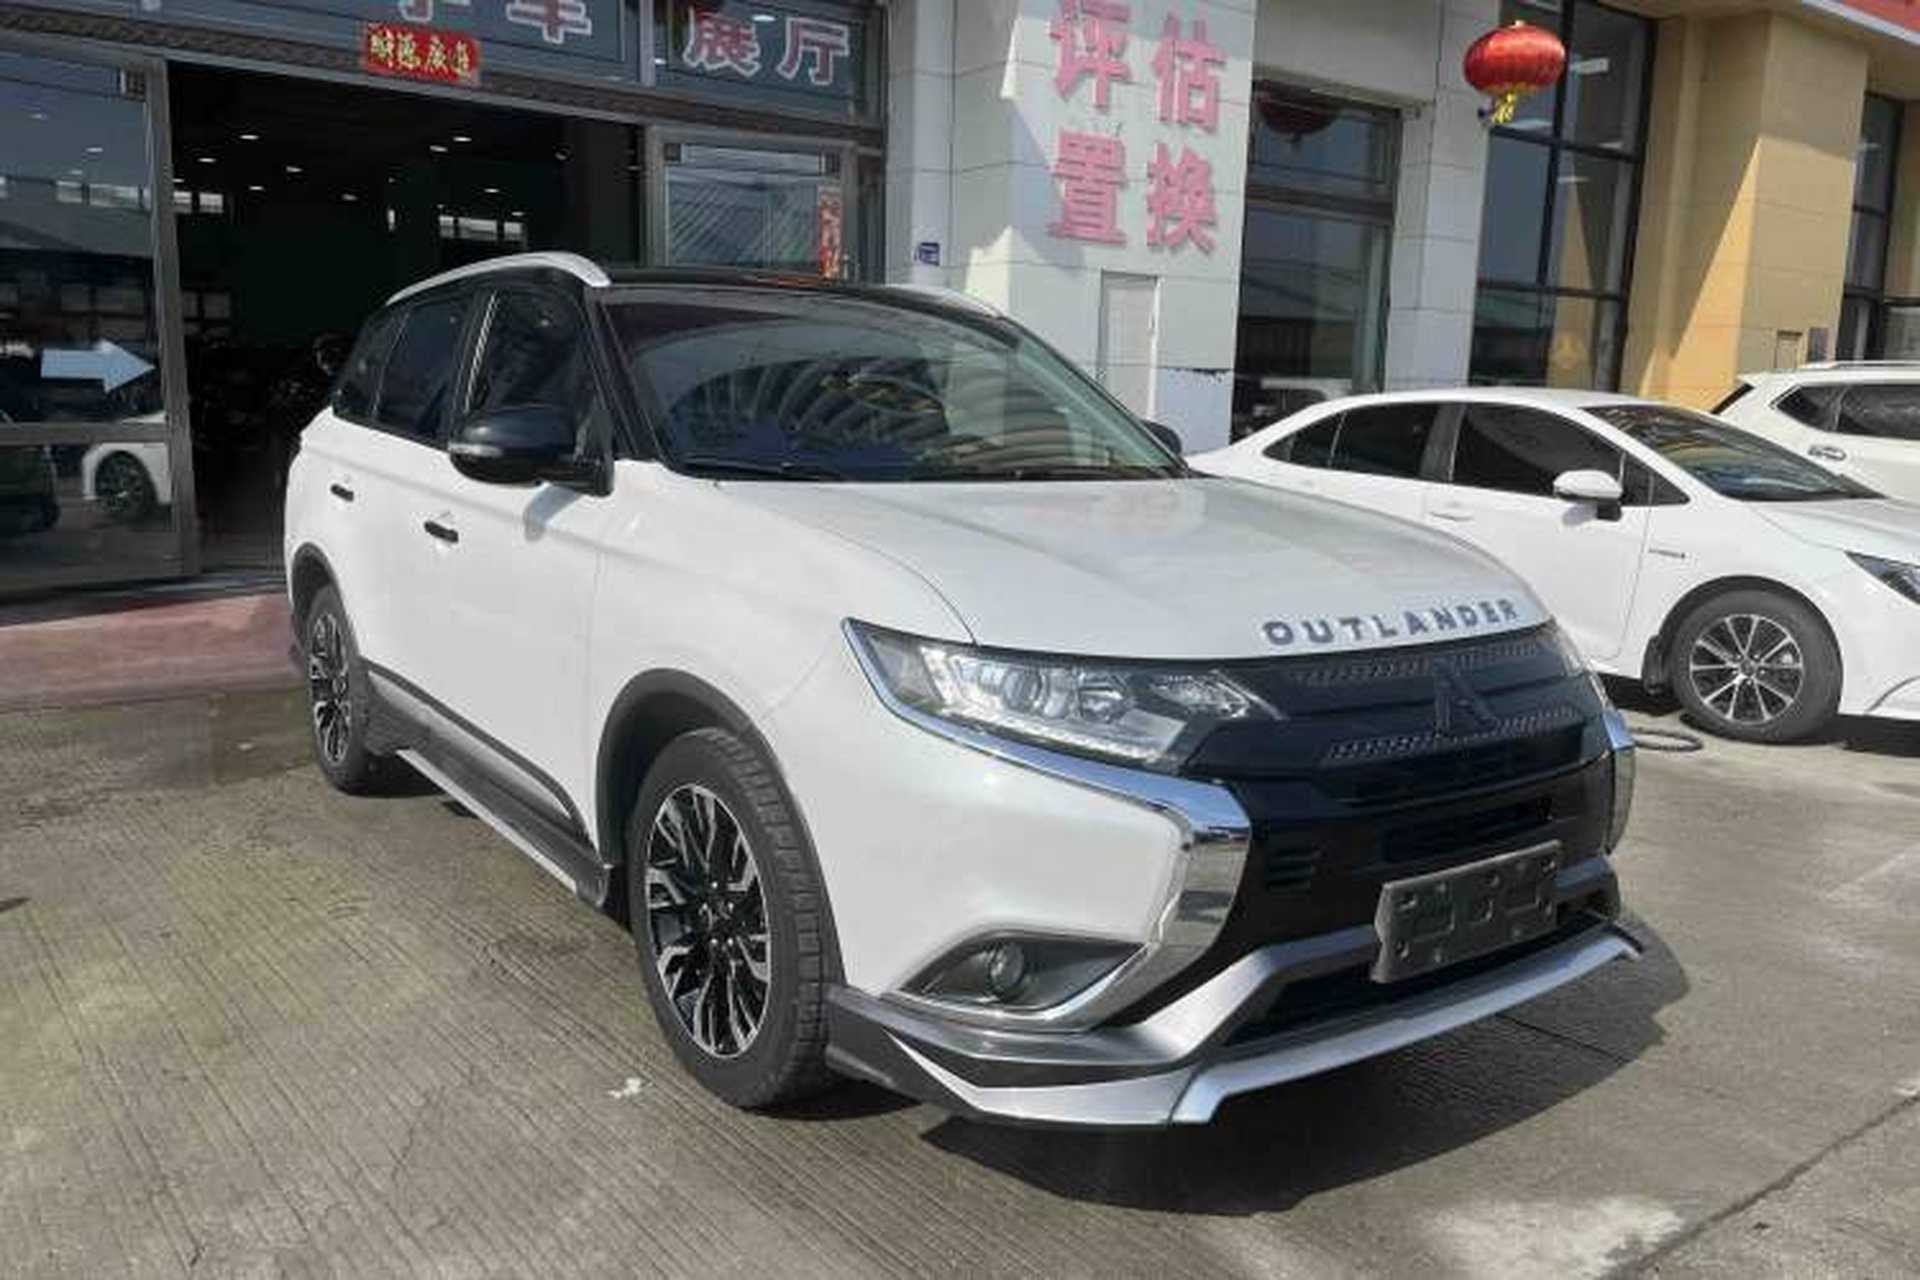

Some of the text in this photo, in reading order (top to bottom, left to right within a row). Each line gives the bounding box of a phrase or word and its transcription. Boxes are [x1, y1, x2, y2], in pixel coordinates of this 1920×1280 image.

[1047, 0, 1227, 134] 评估
[1047, 128, 1217, 255] 置换
[1263, 598, 1519, 646] OUTLANDER
